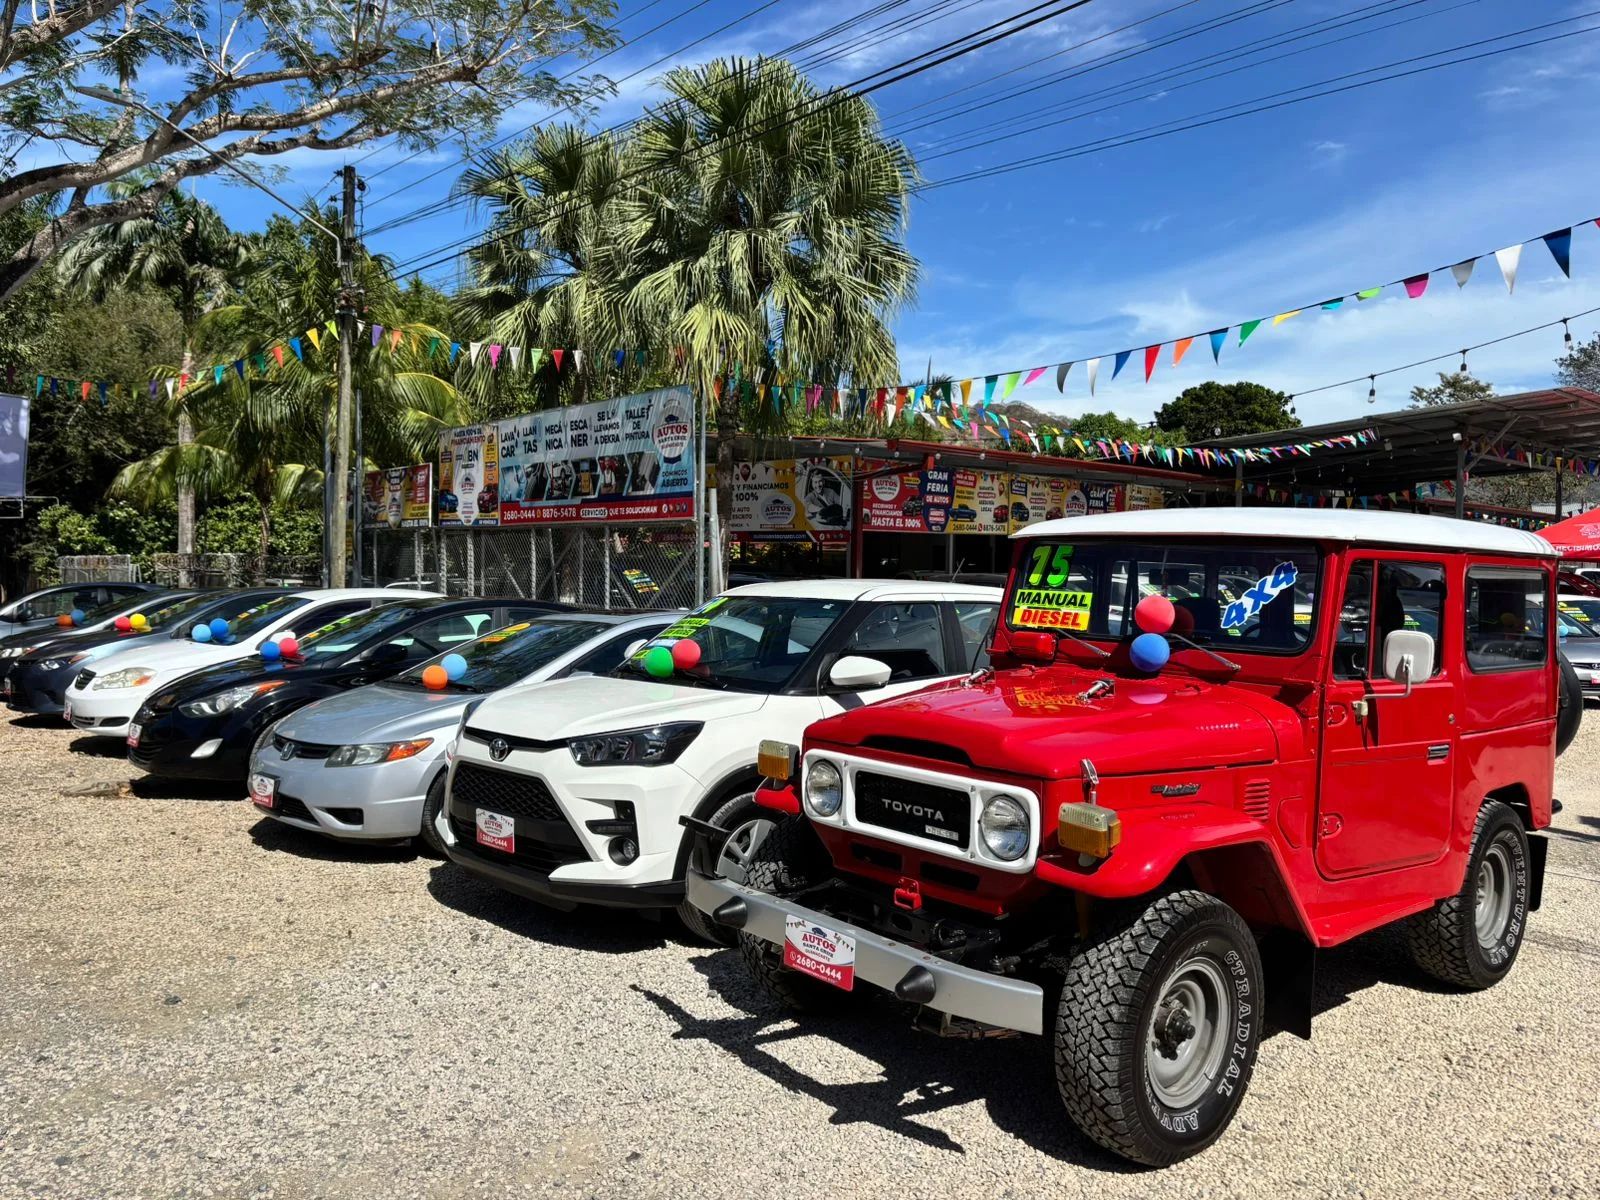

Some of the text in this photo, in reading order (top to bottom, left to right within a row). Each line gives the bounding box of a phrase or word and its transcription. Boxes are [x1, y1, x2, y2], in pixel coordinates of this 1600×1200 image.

[597, 411, 605, 421] SE
[545, 421, 563, 435] MECÁ
[570, 419, 588, 431] ESCA
[594, 422, 620, 433] LLEVAMOS
[633, 421, 641, 430] DE
[657, 424, 688, 438] AUTOS
[501, 431, 515, 443] LAVA
[523, 426, 537, 437] LLAN
[625, 430, 650, 441] PINTURA
[545, 438, 563, 451] NICA
[570, 433, 588, 448] NER
[594, 434, 620, 445] A DEKRA
[501, 444, 515, 458] CAR
[523, 440, 538, 454] TAS
[468, 449, 479, 462] BN
[662, 468, 688, 477] DOMINGOS
[927, 470, 949, 481] GRAN
[661, 478, 688, 487] ABIERTO
[743, 482, 789, 491] FINANCIAMOS
[875, 479, 898, 487] AUTOS
[926, 482, 949, 493] FERIA
[735, 493, 759, 501] 100%
[503, 509, 536, 520] 2680-0444
[542, 507, 577, 519] 8876-5478
[581, 508, 607, 517] SERVICIOS
[609, 507, 619, 516] QUE
[619, 507, 625, 515] TE
[626, 505, 658, 515] SOLUCIONAN
[871, 516, 921, 528] HASTA EL 100%
[1555, 544, 1600, 552] RECIBIMO
[1017, 591, 1088, 607] MANUAL
[1221, 561, 1298, 629] 4X4
[1020, 608, 1081, 627] DIESEL
[881, 798, 944, 822] TOYOTA
[484, 819, 502, 830] AUTOS
[802, 933, 836, 953] AUTOS
[802, 942, 833, 958] SANTA CRUZ
[796, 954, 842, 981] 2680-0444
